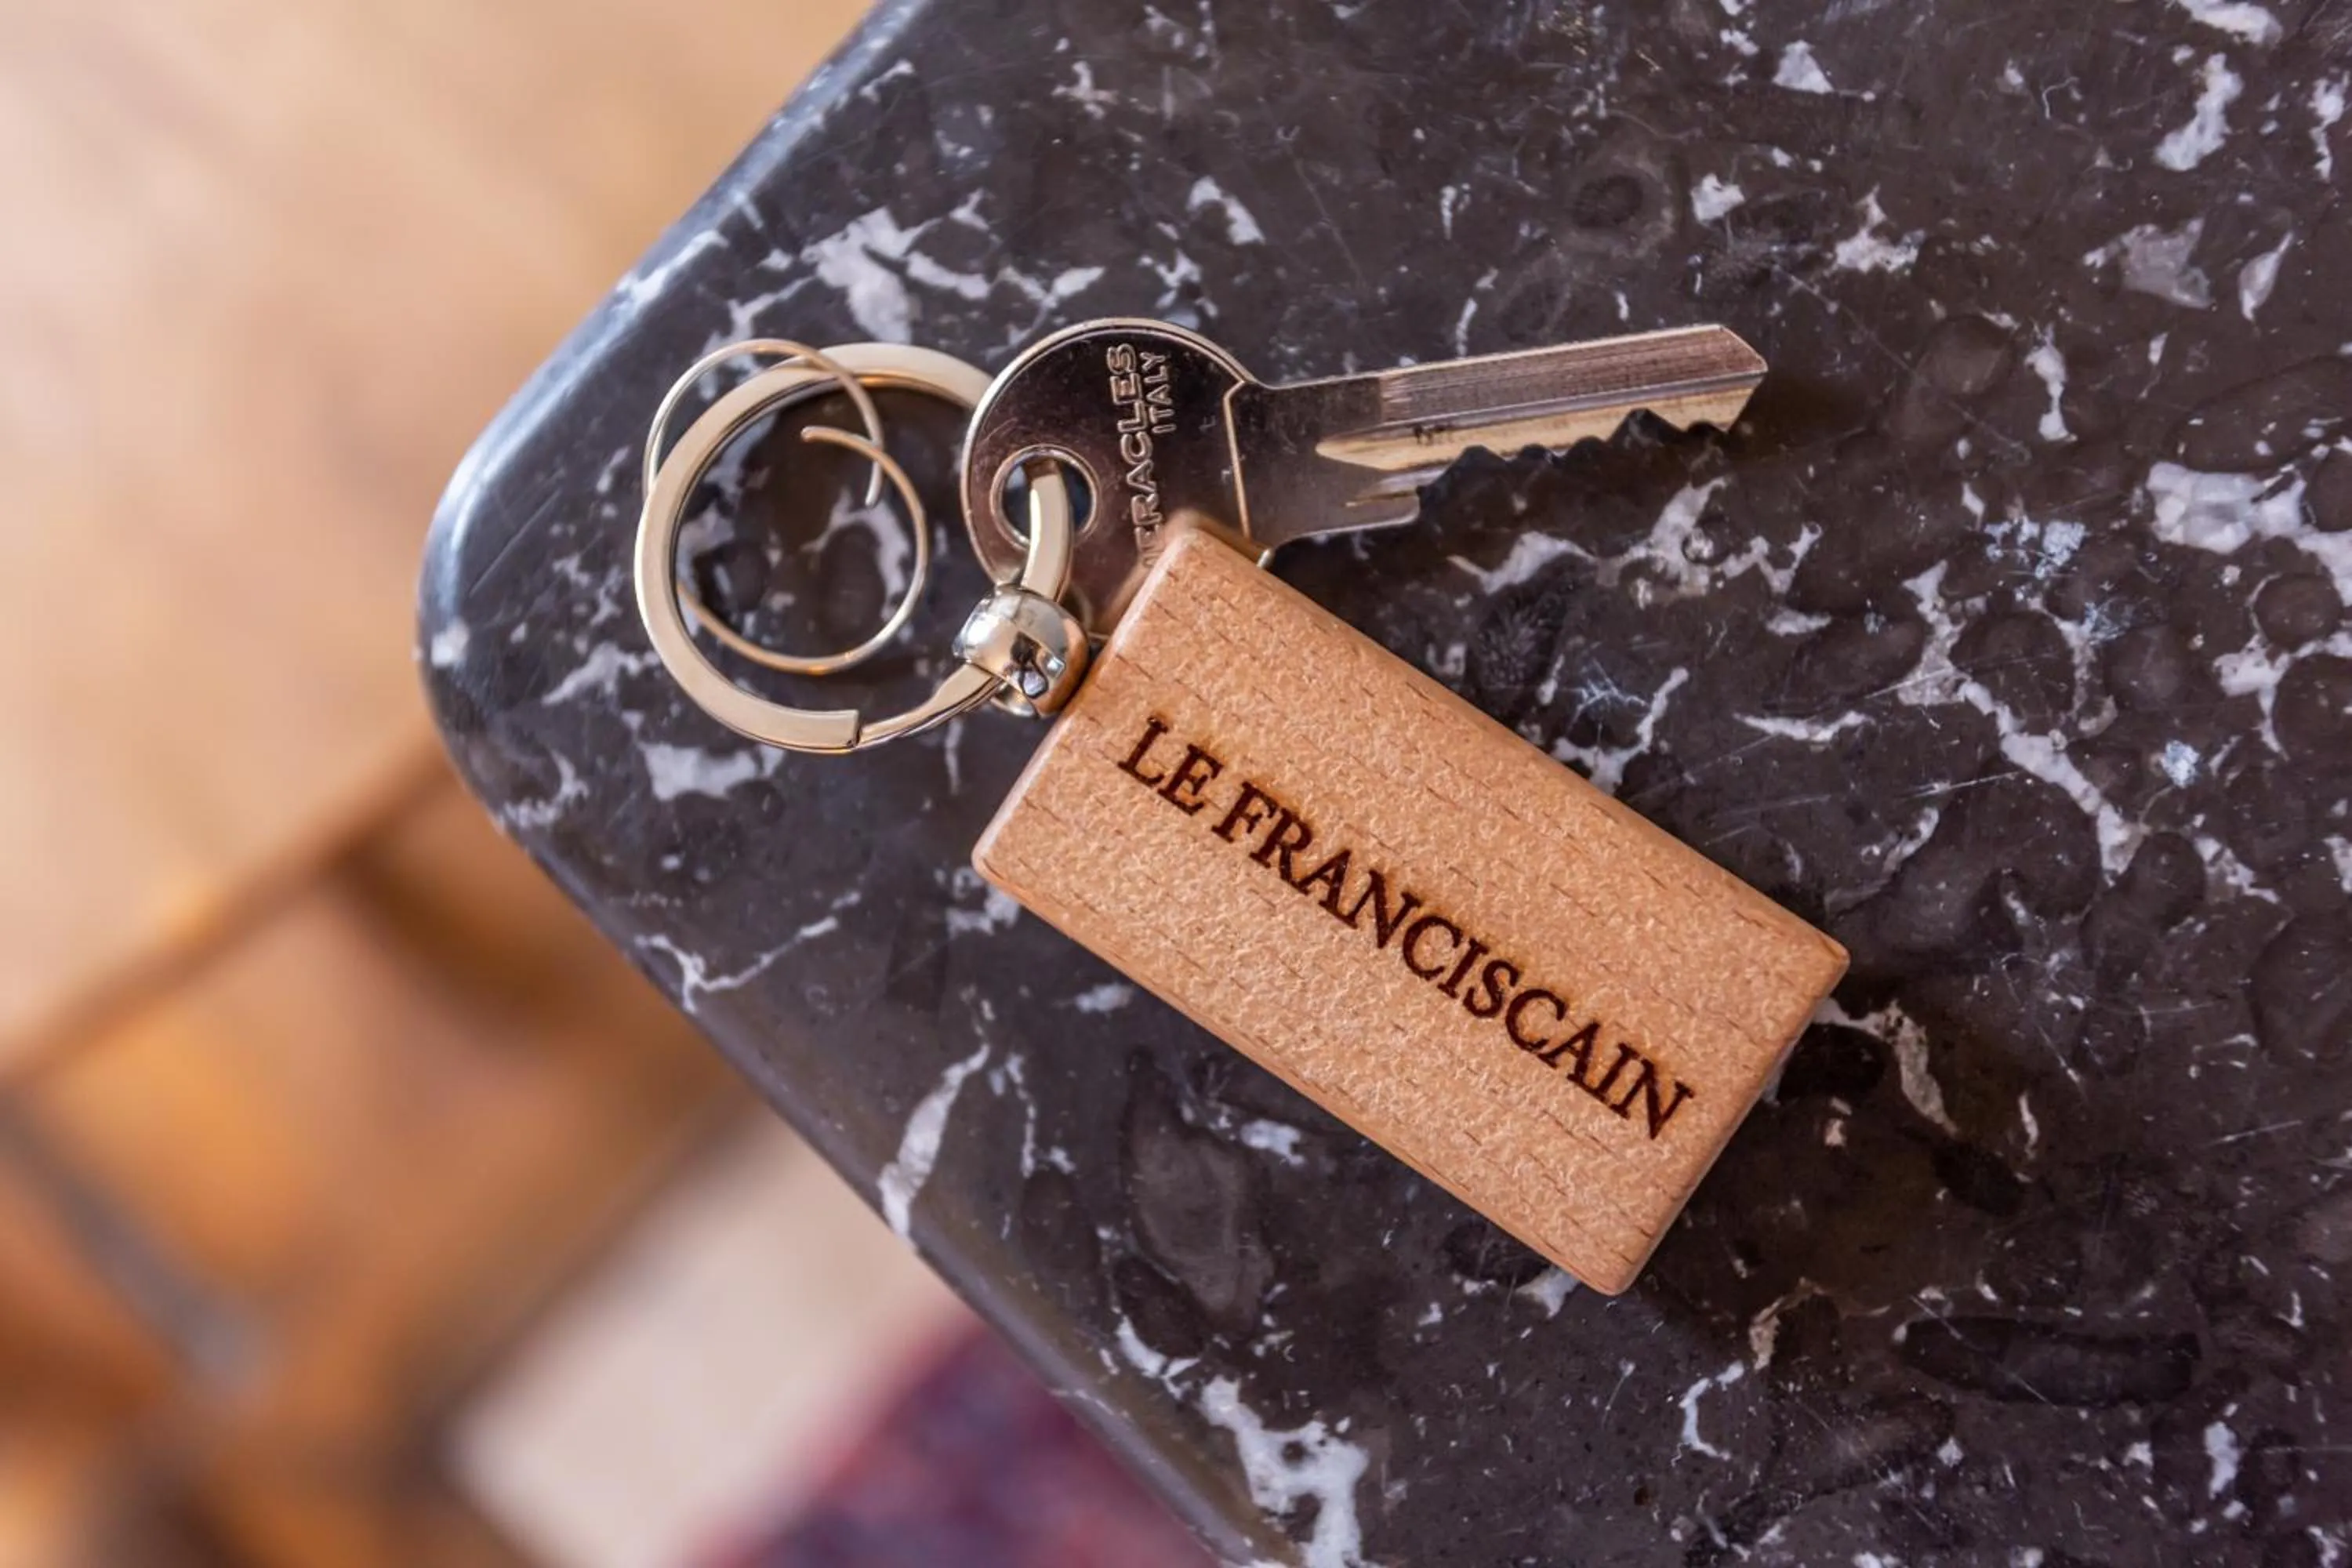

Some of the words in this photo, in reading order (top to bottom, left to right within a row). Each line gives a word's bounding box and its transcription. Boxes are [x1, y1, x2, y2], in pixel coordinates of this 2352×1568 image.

[1106, 343, 1163, 567] ERACLES
[1139, 351, 1175, 434] ITALY
[1117, 716, 1224, 816] LE
[1211, 781, 1695, 1140] FRANCISCAIN
